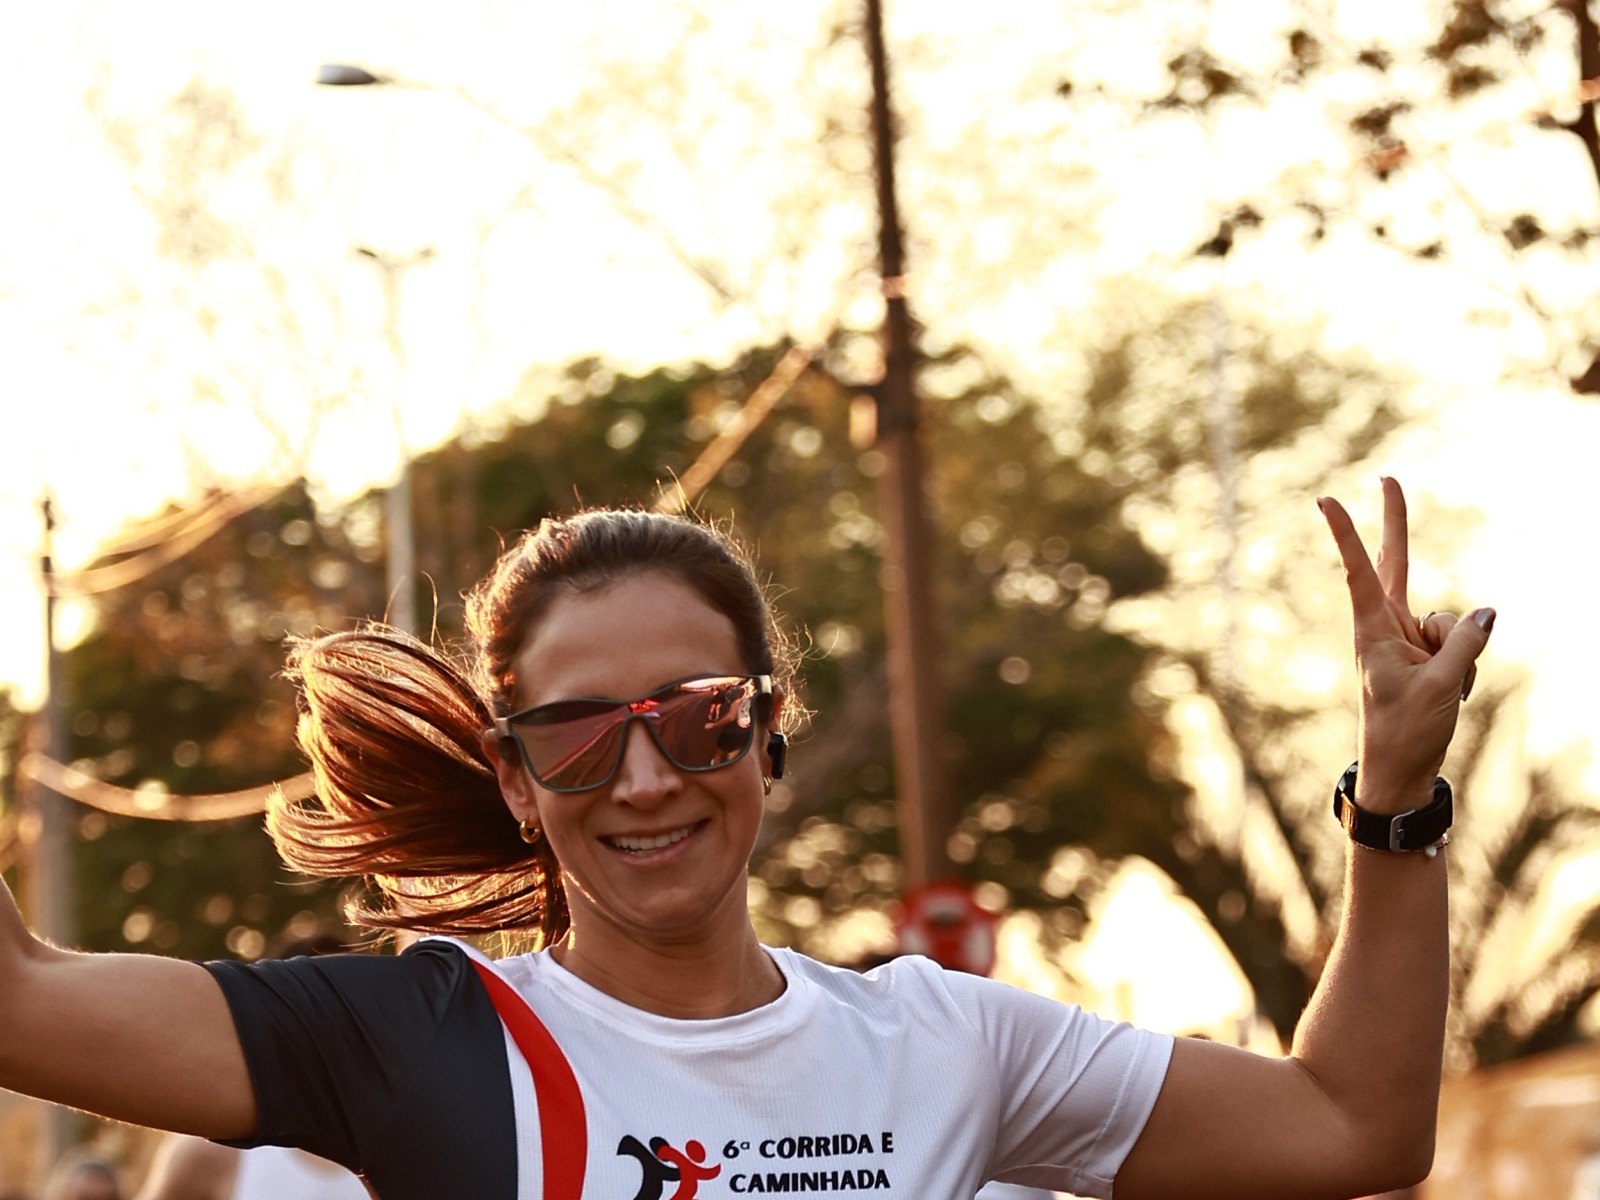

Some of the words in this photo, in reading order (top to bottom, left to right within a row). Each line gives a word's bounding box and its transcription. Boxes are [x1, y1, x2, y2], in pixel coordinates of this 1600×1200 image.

[759, 1133, 874, 1159] CORRIDA
[881, 1131, 894, 1154] E
[729, 1169, 891, 1193] CAMINHADA
